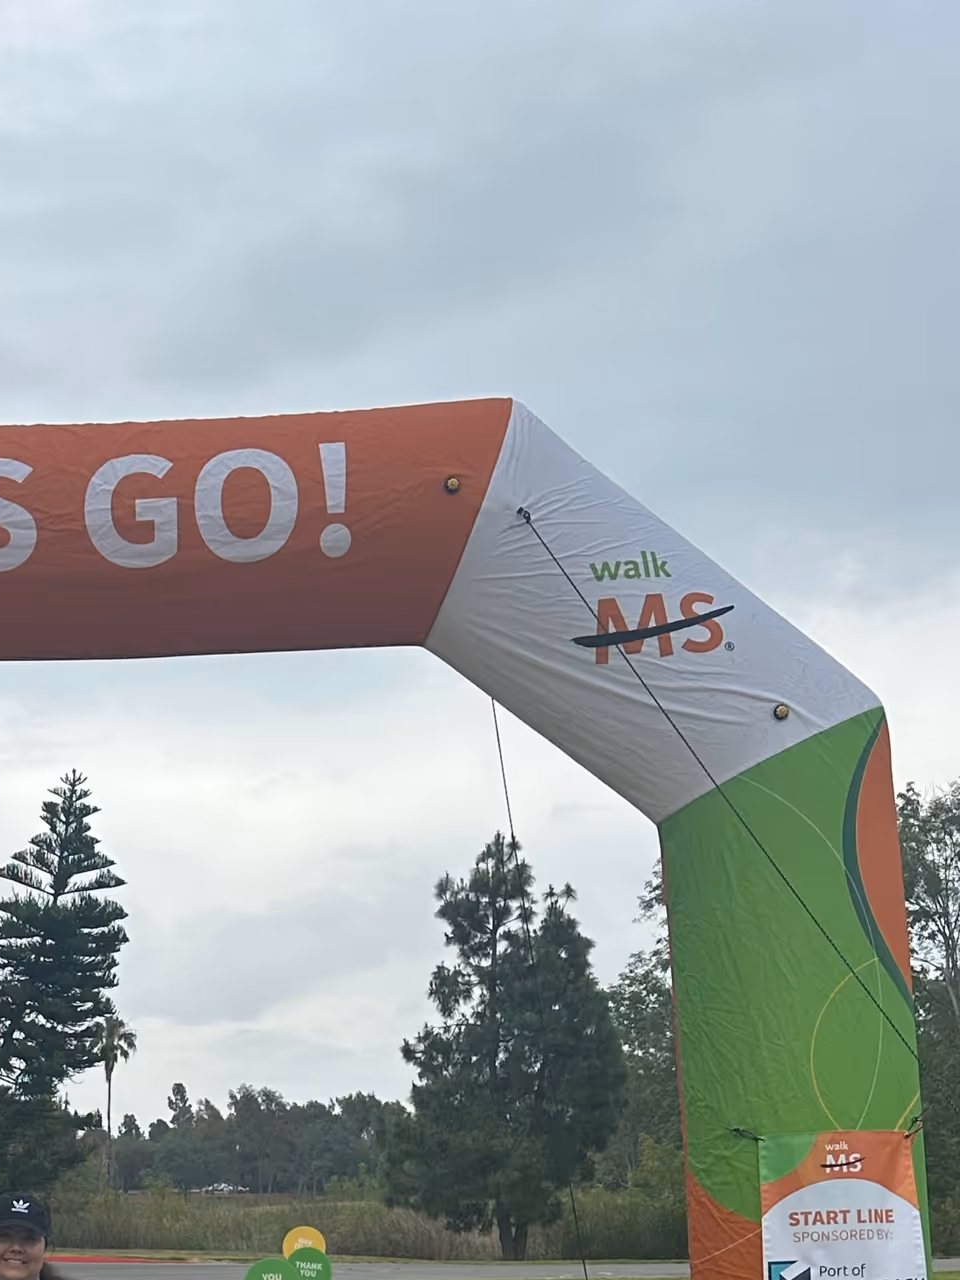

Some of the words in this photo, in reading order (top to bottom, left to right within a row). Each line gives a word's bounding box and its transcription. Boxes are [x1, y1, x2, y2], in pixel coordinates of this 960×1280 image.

[83, 441, 353, 569] GO!
[589, 550, 673, 582] walk
[594, 591, 724, 665] MS
[824, 1140, 849, 1151] walk
[825, 1153, 863, 1174] MS
[787, 1209, 852, 1227] START
[856, 1208, 895, 1224] LINE
[792, 1228, 875, 1243] SPONSORED
[876, 1228, 894, 1241] BY:
[295, 1261, 323, 1271] THANK
[300, 1269, 317, 1278] YOU
[819, 1264, 849, 1277] Port
[851, 1263, 866, 1278] of
